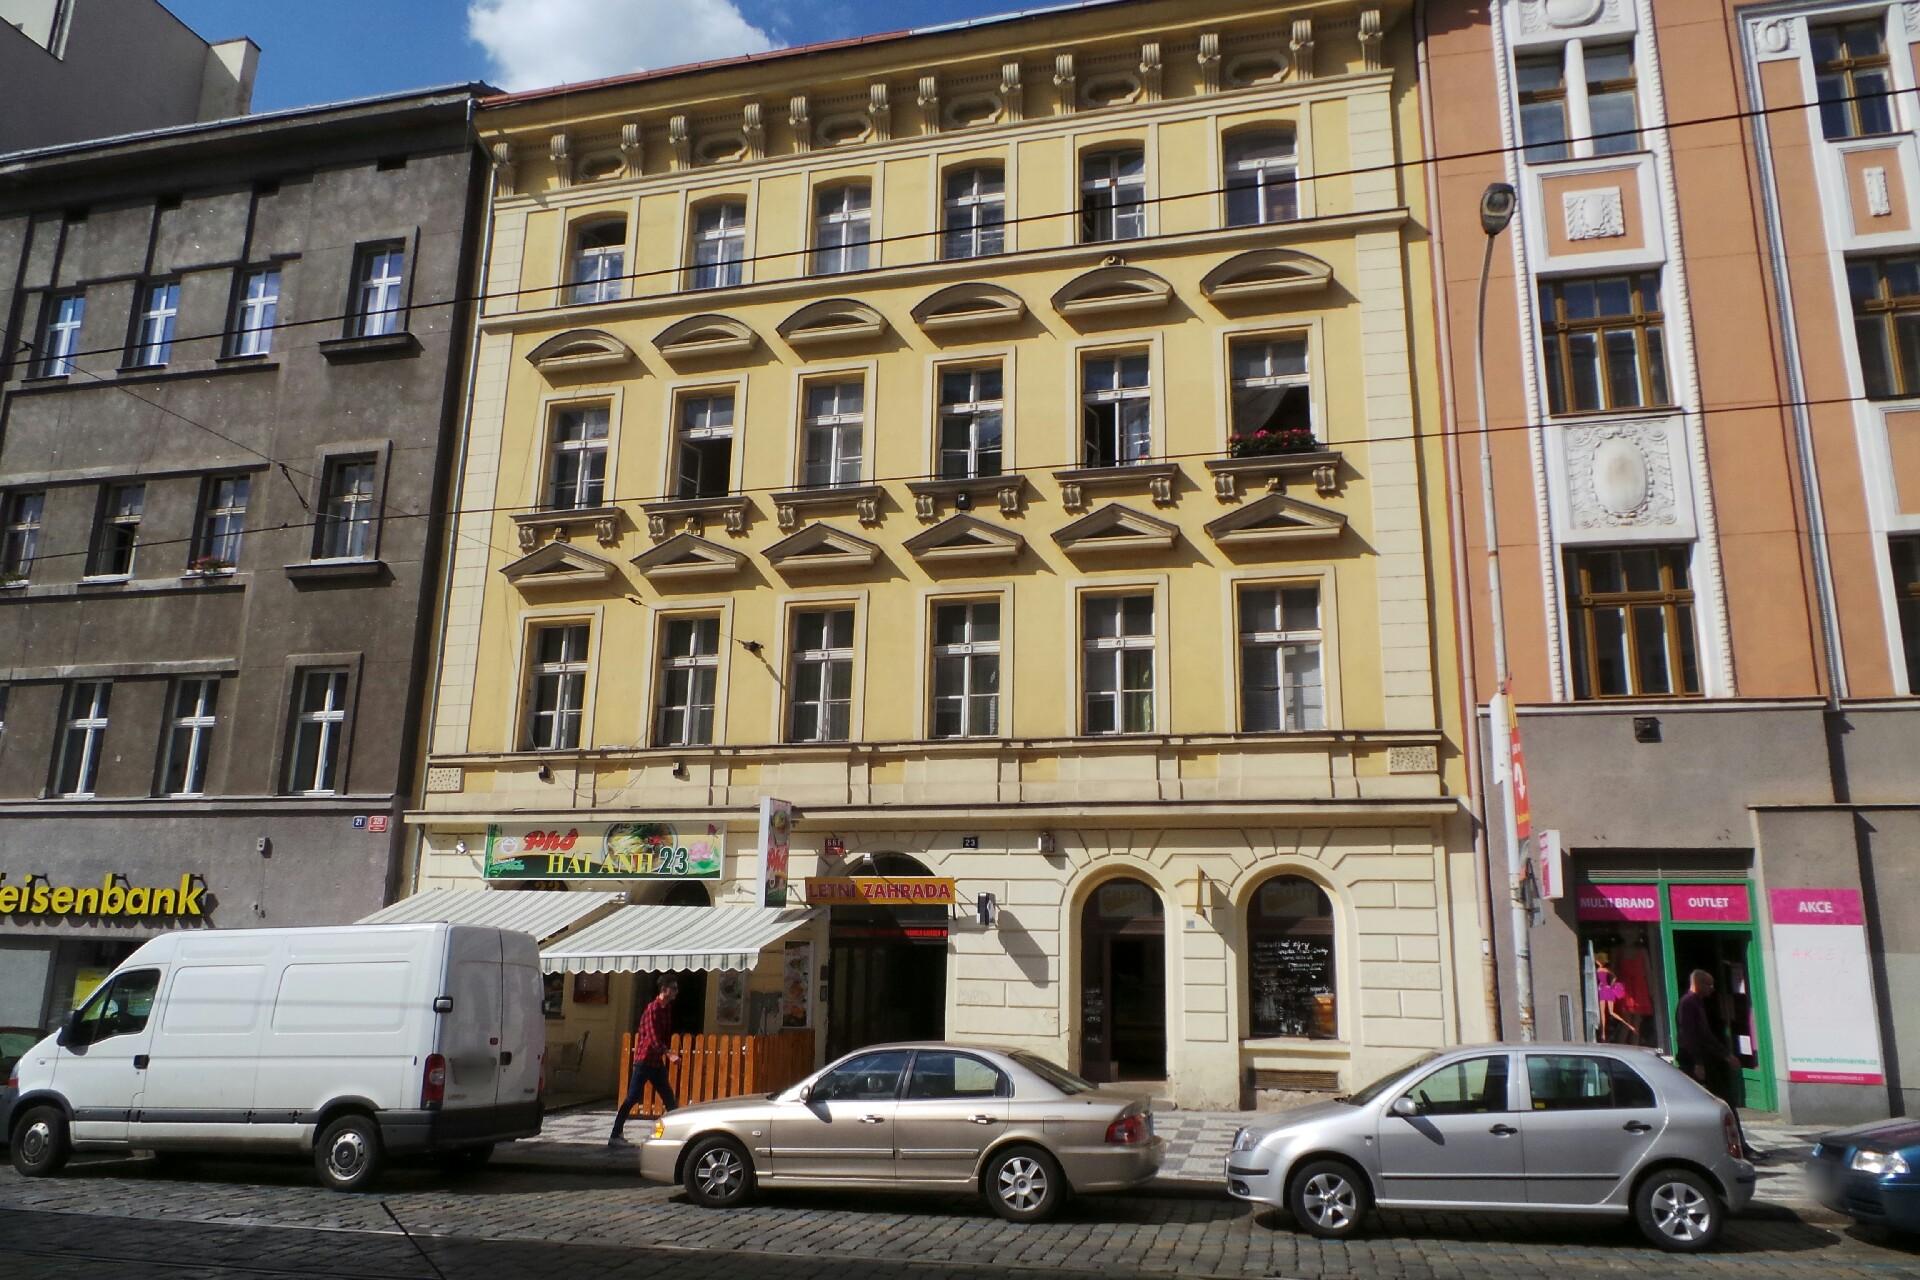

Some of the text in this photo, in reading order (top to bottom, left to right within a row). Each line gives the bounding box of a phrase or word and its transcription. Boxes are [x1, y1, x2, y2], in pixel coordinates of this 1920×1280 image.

[355, 818, 363, 826] 21
[965, 839, 976, 847] 23
[546, 852, 593, 874] HAI
[598, 853, 654, 874] ANH
[658, 846, 689, 876] 23
[863, 882, 951, 899] ZAHRADA
[1688, 897, 1729, 908] OUTLET
[1799, 901, 1834, 914] AKCE
